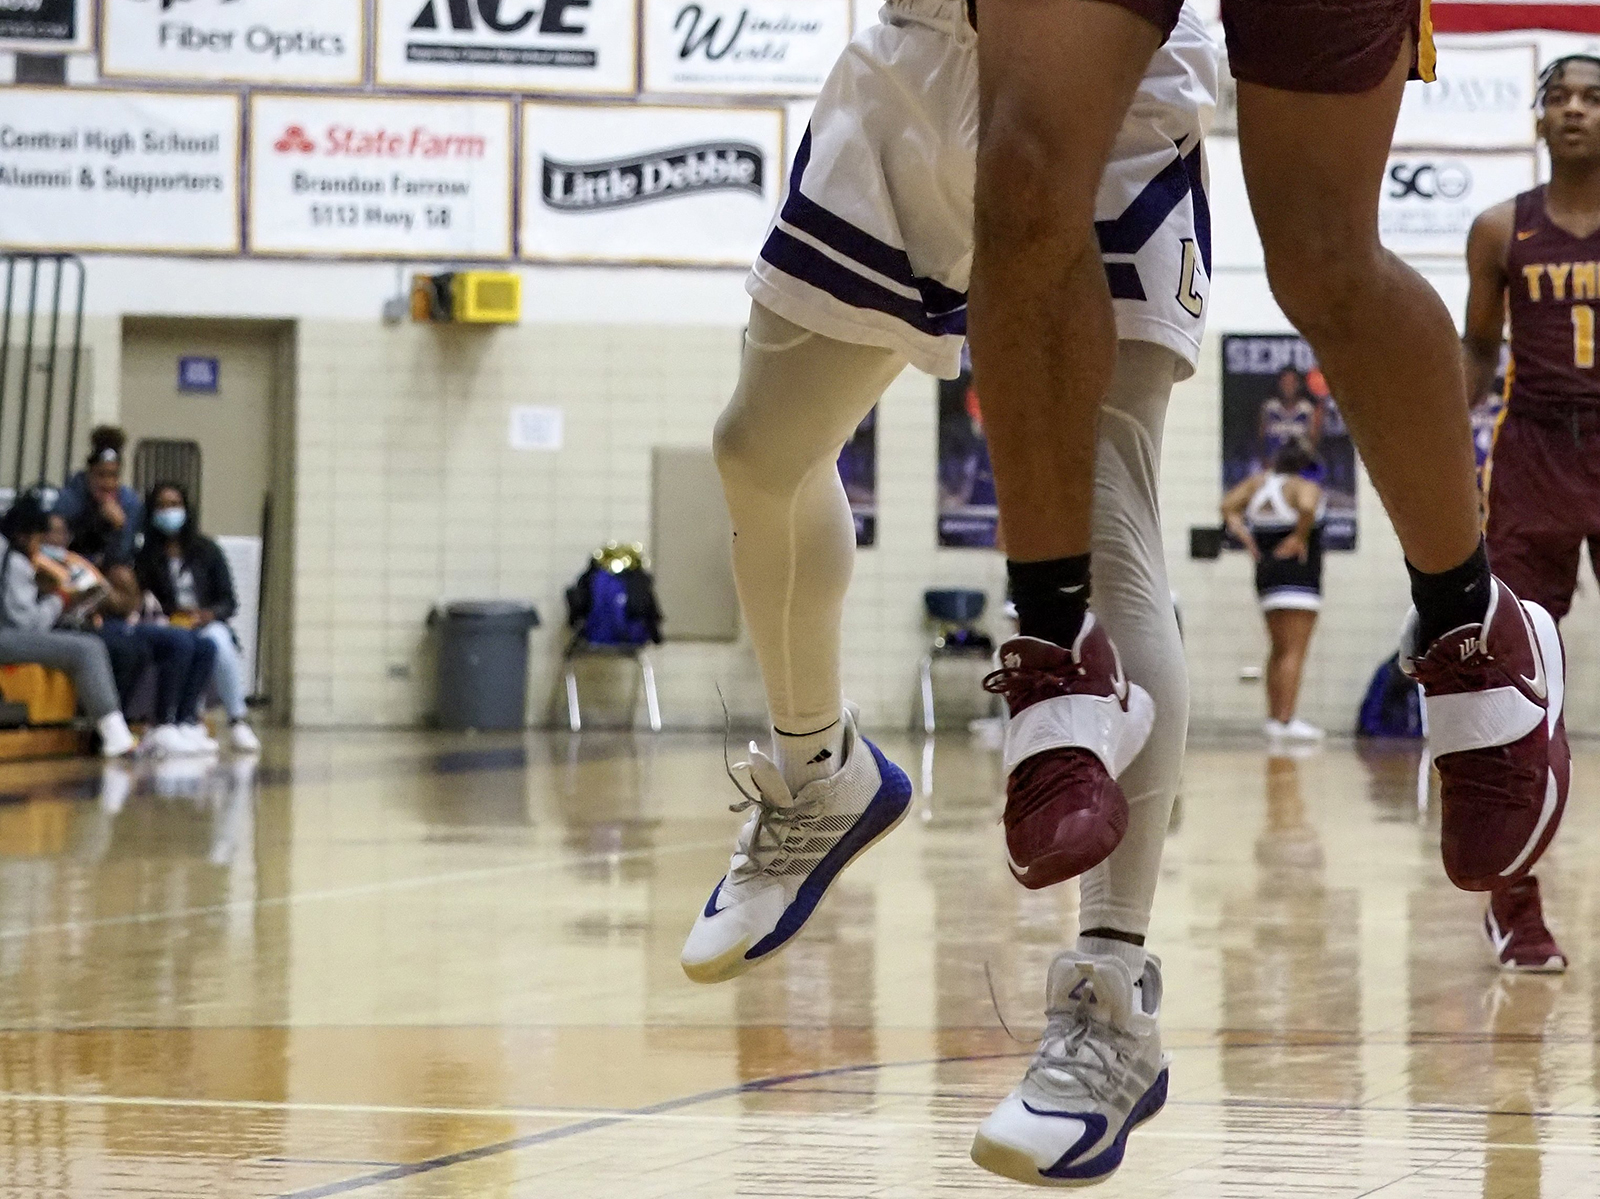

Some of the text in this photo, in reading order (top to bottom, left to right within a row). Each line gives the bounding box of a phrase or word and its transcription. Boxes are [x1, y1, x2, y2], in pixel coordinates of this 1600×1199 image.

[160, 22, 345, 60] Fiber Optics
[0, 126, 219, 158] Central High School
[78, 166, 95, 189] &
[103, 166, 223, 196] Supporters
[292, 170, 385, 193] Brandon
[551, 150, 757, 205] Little Debbie
[1521, 261, 1600, 302] TYN
[1571, 304, 1595, 369] 1
